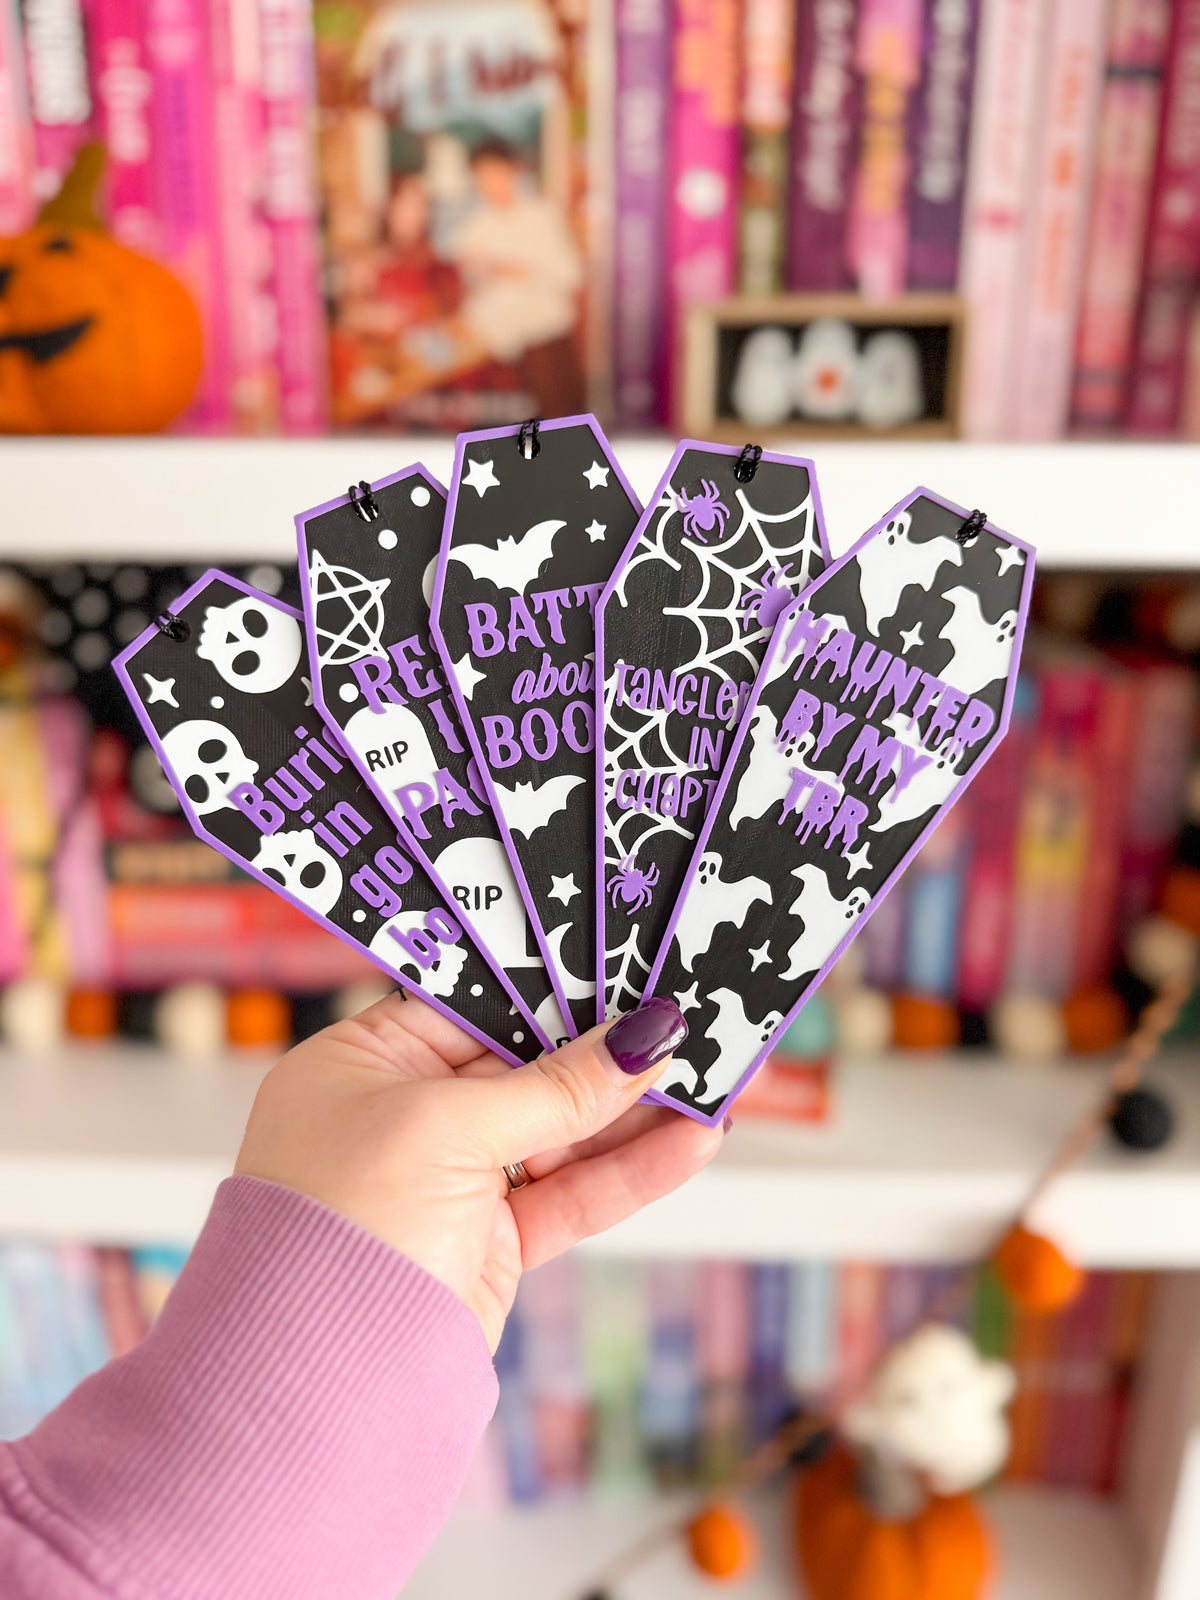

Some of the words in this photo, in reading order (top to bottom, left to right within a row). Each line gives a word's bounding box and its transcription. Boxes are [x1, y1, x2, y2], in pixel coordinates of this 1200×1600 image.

[349, 632, 450, 714] RE
[782, 609, 995, 759] HAUNTED
[365, 740, 409, 772] RIP
[688, 726, 724, 771] IN
[774, 689, 856, 762] BY
[836, 724, 934, 803] MY
[300, 801, 373, 858] in
[778, 767, 869, 857] TBR
[350, 831, 421, 918] go
[452, 885, 503, 911] RIP
